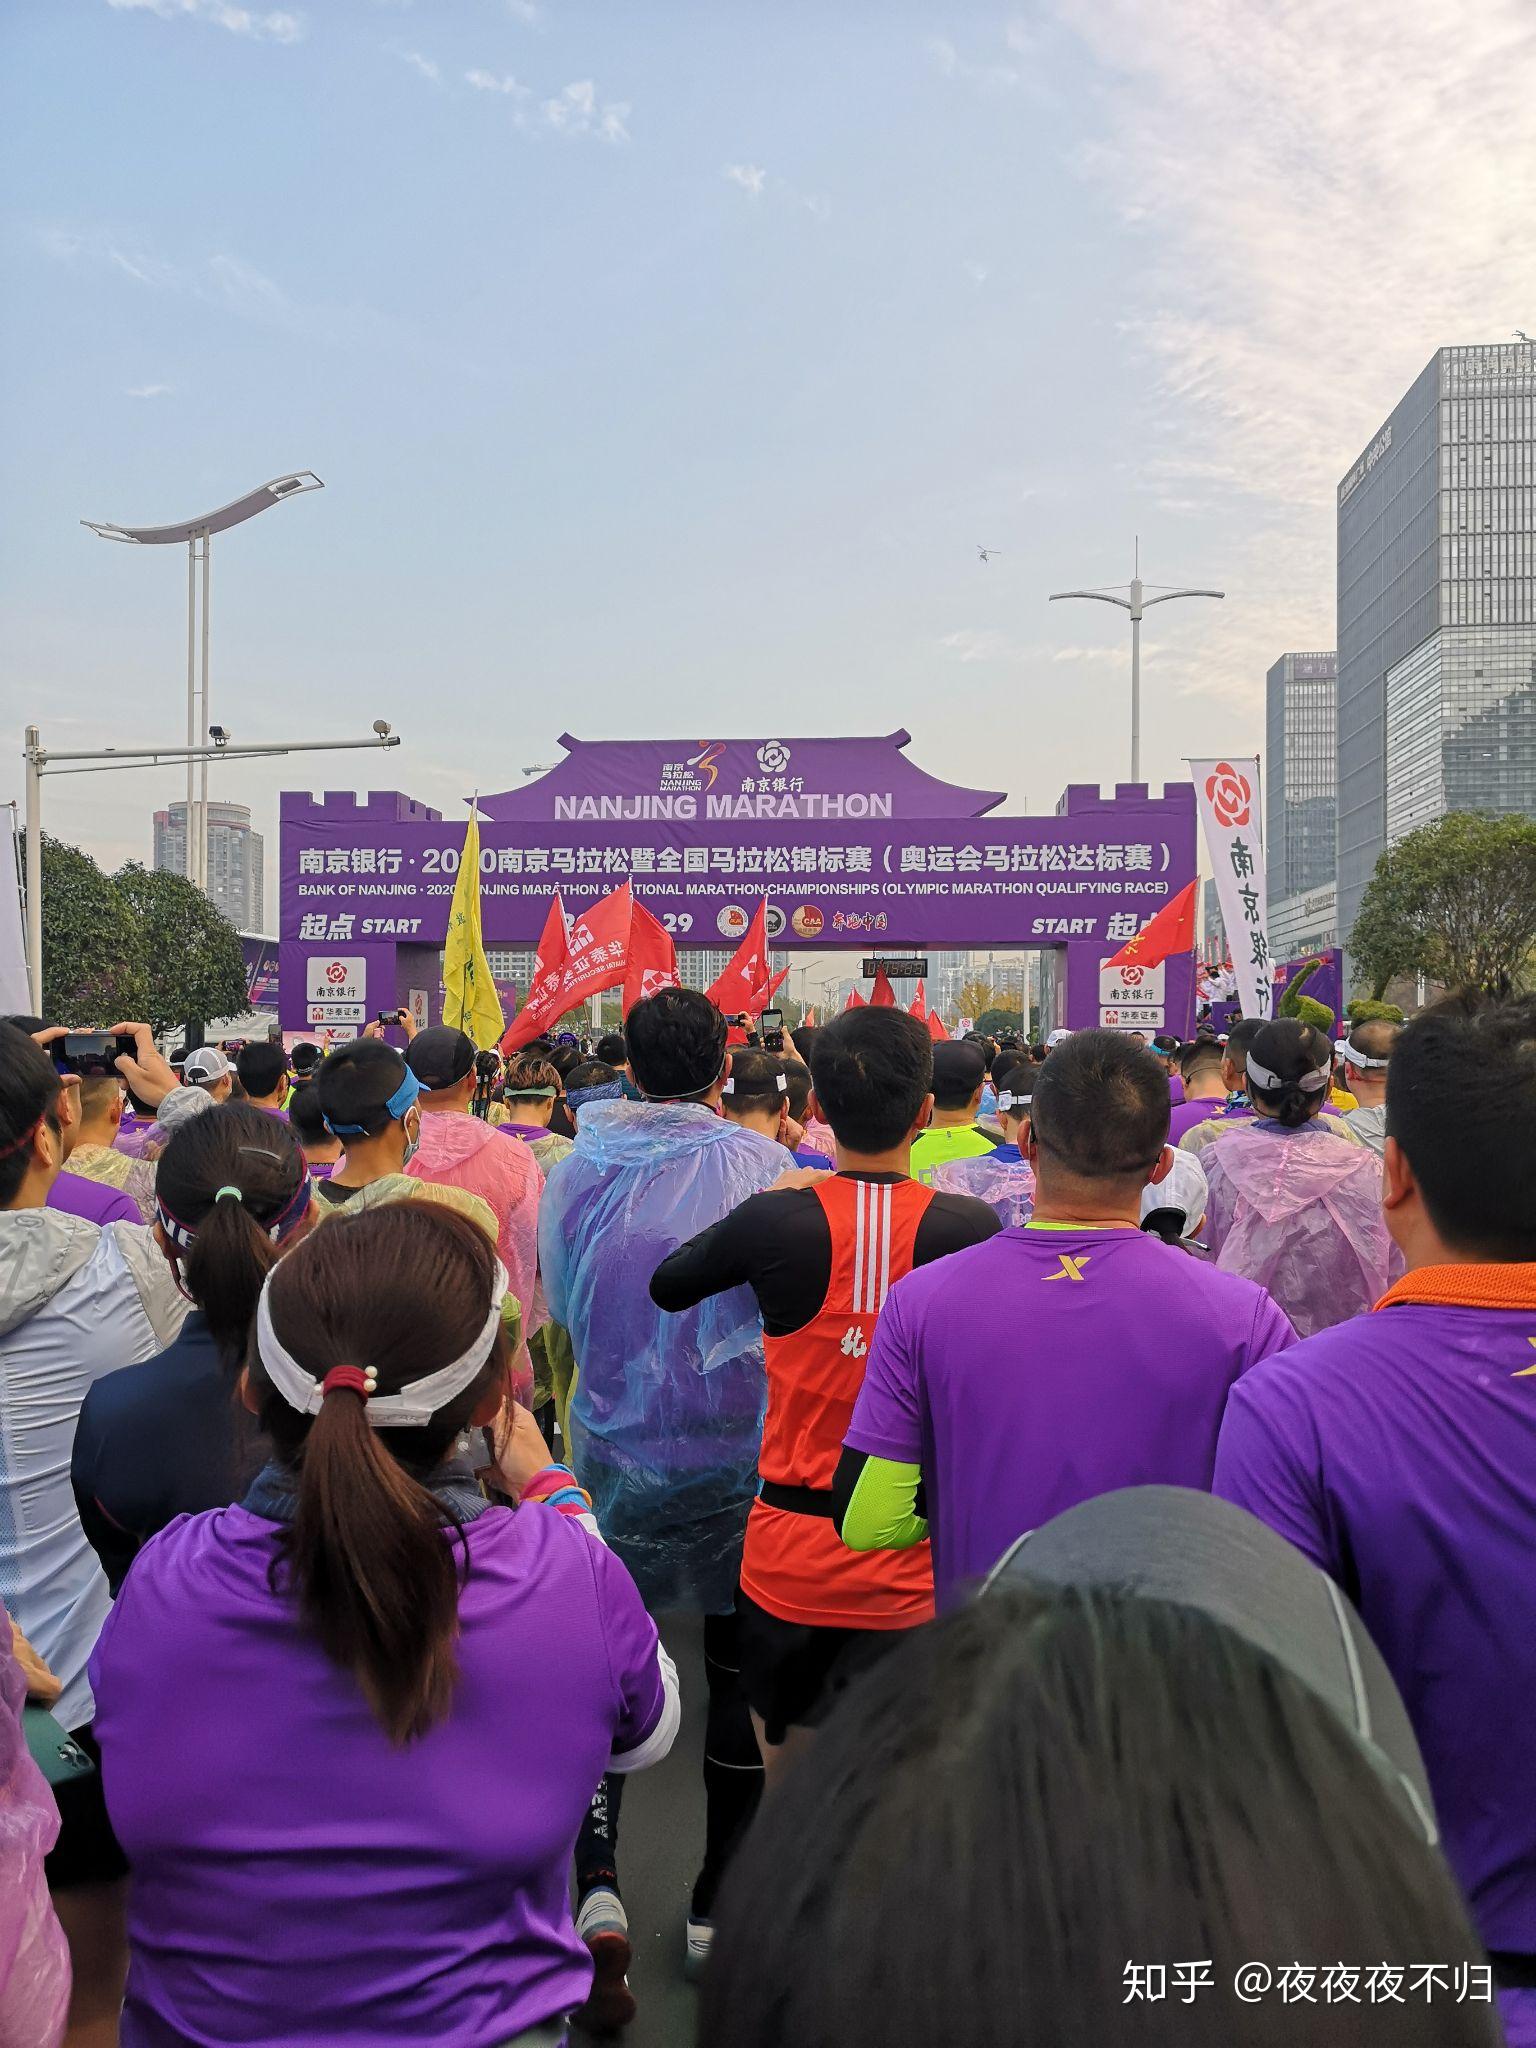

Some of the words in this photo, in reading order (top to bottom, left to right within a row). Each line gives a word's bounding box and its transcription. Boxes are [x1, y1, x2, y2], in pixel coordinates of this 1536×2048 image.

[741, 777, 804, 793] 南京银行
[554, 795, 697, 820] NANJING
[706, 793, 892, 818] MARATHON
[298, 884, 335, 895] BANK
[338, 884, 356, 895] OF
[358, 884, 416, 895] NANJING
[602, 883, 612, 895] &
[686, 883, 764, 895] MARATHON
[767, 883, 880, 895] CHAMPIONSHIPS
[882, 882, 949, 895] (OLYMPIC
[952, 882, 1033, 894] MARATHON
[1036, 882, 1122, 896] QUALIFYING
[1124, 881, 1169, 895] RACE)
[299, 912, 356, 941] 起点
[361, 918, 422, 934] START
[832, 911, 888, 931] 奔跑中国
[1031, 918, 1098, 934] START
[1231, 836, 1270, 1016] 南京银行
[316, 986, 357, 998] 南京银行
[1110, 989, 1155, 1000] 南京银行
[1121, 1011, 1159, 1020] 华泰证券
